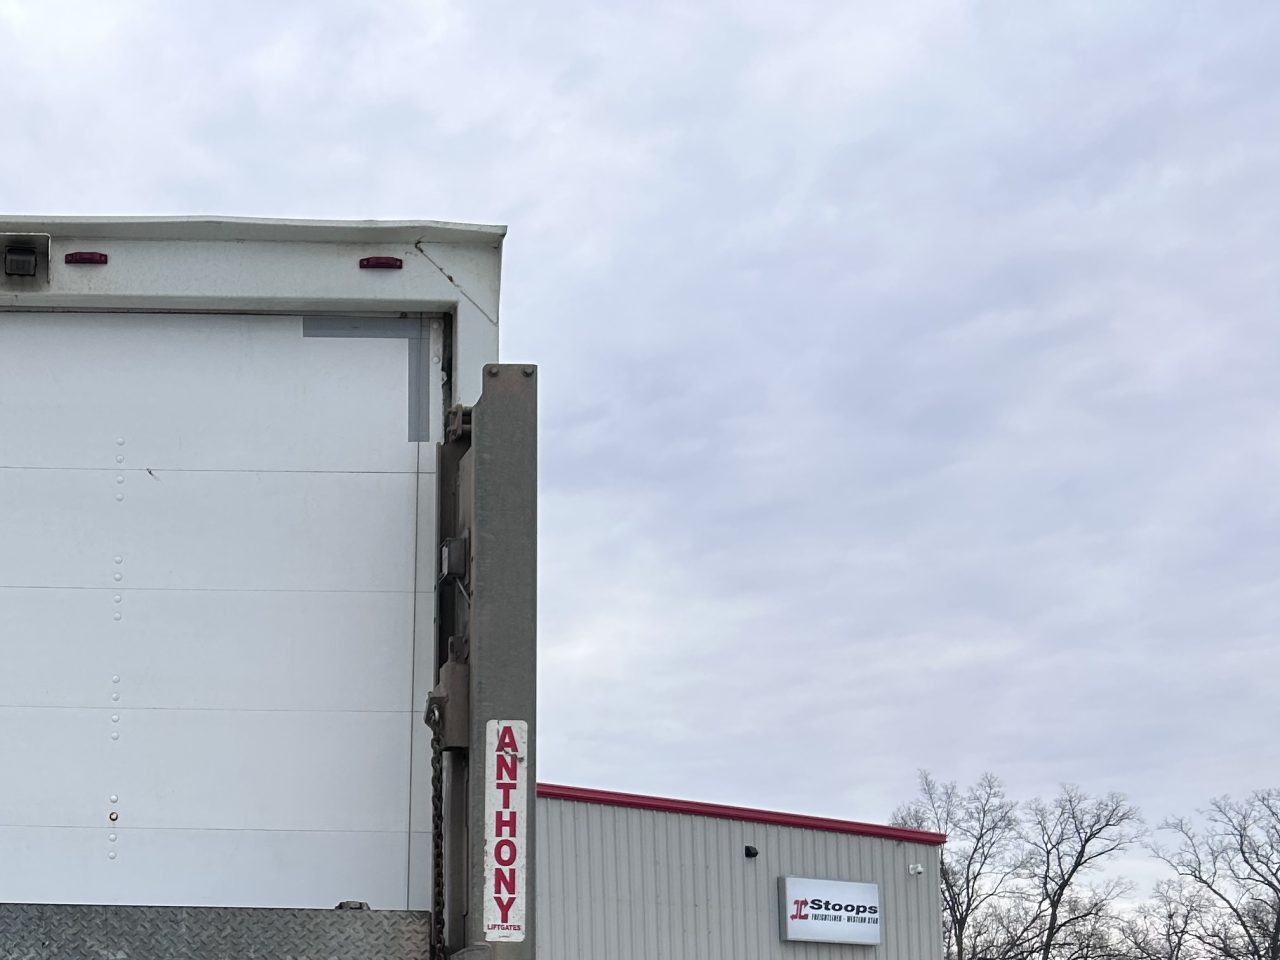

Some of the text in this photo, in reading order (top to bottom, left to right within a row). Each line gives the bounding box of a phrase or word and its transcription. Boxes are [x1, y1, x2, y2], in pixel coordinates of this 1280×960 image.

[493, 726, 519, 923] ANTHONY
[809, 899, 878, 915] Stoops
[487, 923, 521, 931] LIFTGATES
